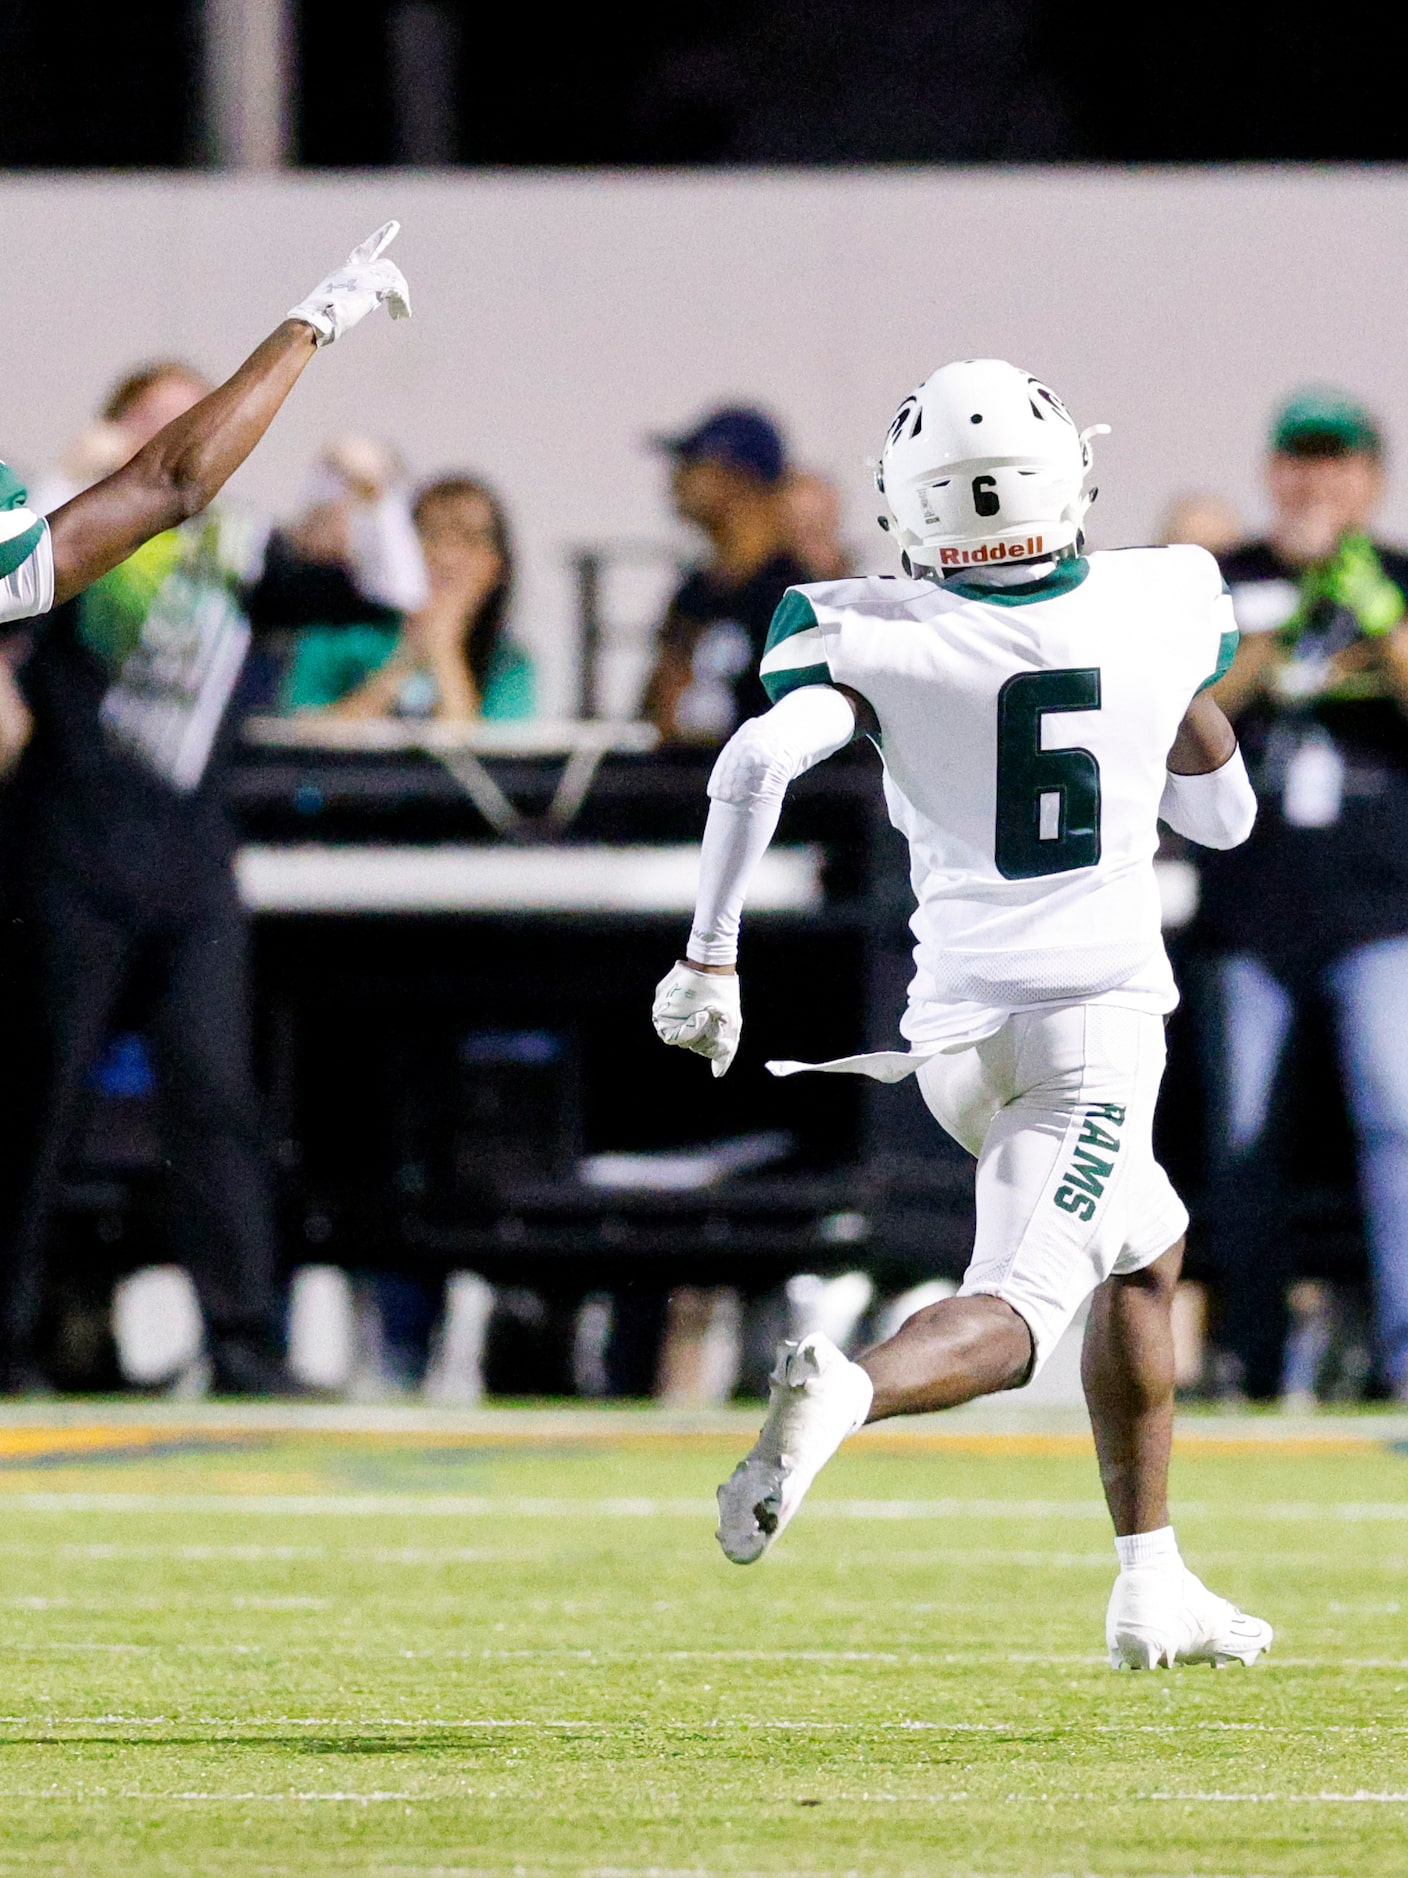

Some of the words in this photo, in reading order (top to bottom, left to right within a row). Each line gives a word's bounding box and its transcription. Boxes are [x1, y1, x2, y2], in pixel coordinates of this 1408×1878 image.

[972, 475, 1000, 517] 6
[939, 536, 1043, 565] Riddell
[995, 667, 1101, 880] 6
[1053, 1102, 1127, 1222] RAMS
